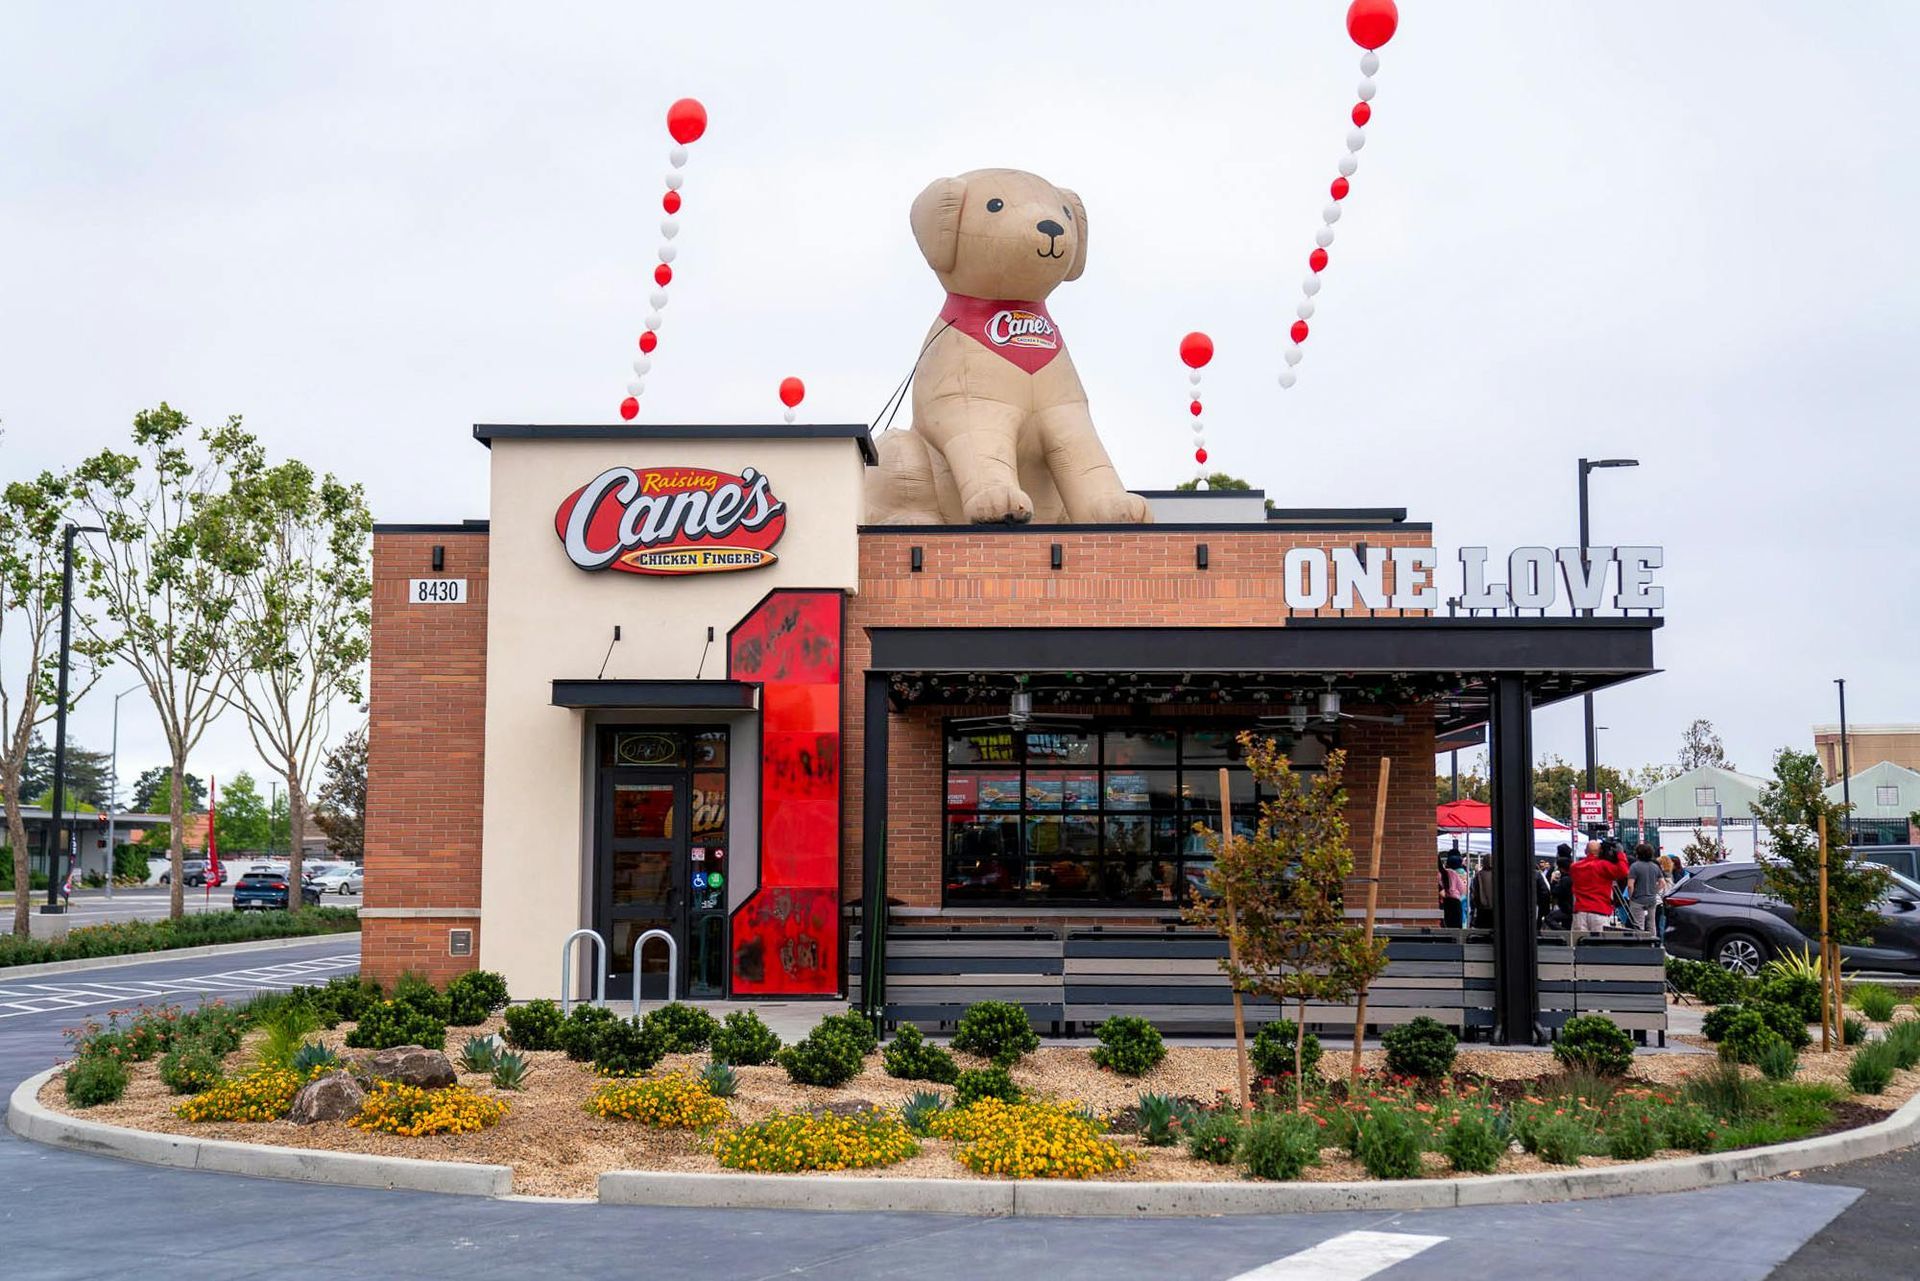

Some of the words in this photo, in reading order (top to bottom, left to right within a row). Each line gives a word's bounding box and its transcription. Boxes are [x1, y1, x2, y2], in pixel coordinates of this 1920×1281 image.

[643, 472, 718, 492] Raising
[564, 466, 785, 569] Cane's
[640, 552, 697, 566] CHICKEN
[702, 551, 760, 565] FINGERS
[1283, 546, 1437, 609] ONE
[1458, 546, 1663, 609] LOVE
[418, 581, 458, 601] 8430
